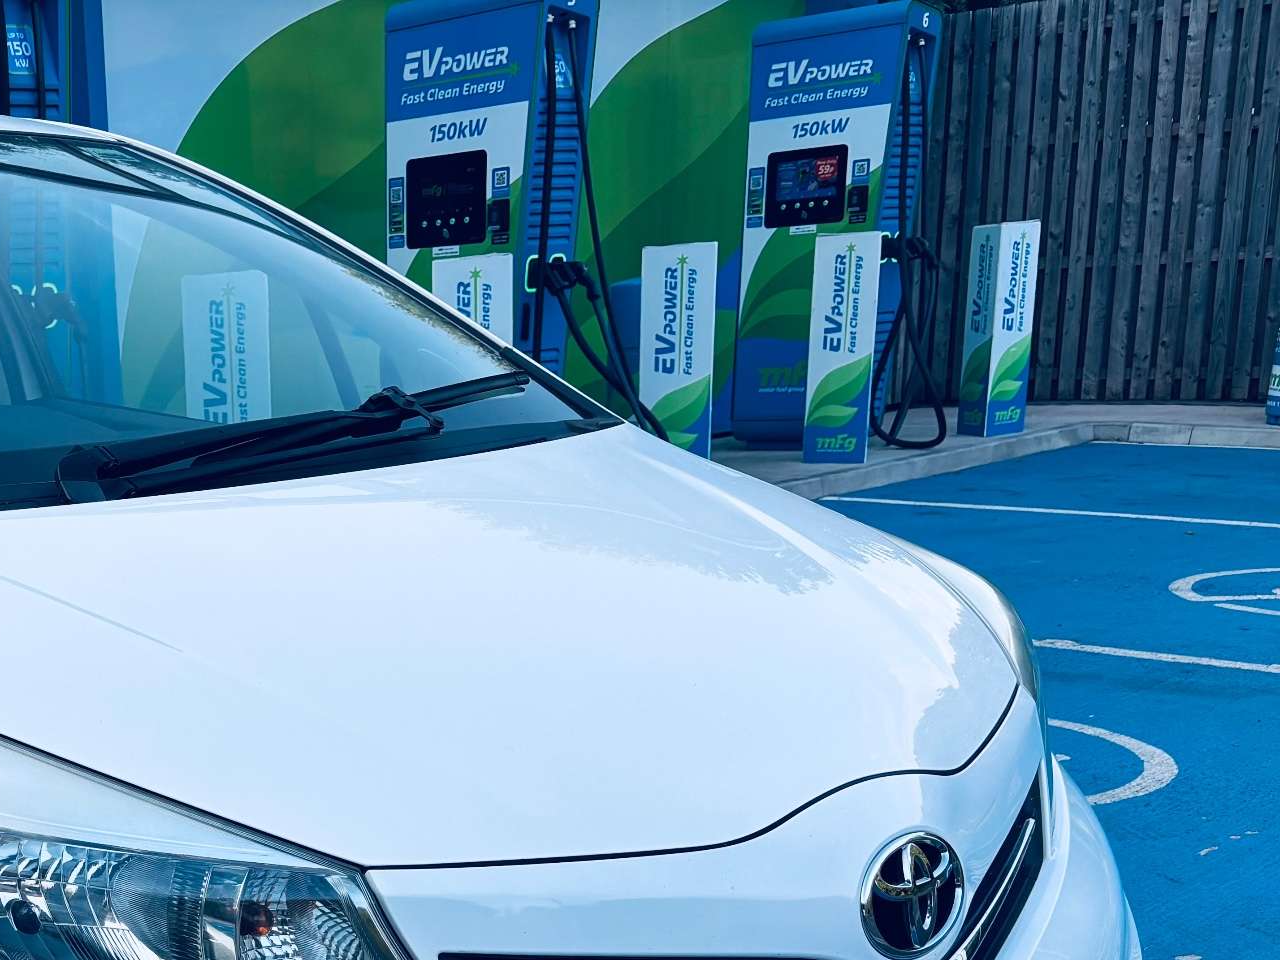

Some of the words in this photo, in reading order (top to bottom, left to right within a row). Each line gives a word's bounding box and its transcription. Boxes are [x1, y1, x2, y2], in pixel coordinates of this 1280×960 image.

[922, 12, 930, 28] 6
[7, 41, 32, 56] 150
[400, 91, 424, 106] Fast
[426, 84, 460, 101] Clean
[462, 79, 505, 96] Energy
[764, 95, 789, 108] Fast
[791, 89, 823, 104] Clean
[826, 85, 869, 100] Energy
[429, 117, 487, 143] 150kW
[791, 117, 850, 139] 150kW
[1022, 242, 1031, 278] Energy
[685, 267, 698, 311] Energy
[852, 255, 864, 296] Energy
[481, 283, 492, 329] Energy
[849, 297, 861, 329] Clean
[235, 302, 246, 354] Energy
[684, 314, 696, 349] Clean
[847, 330, 857, 353] Fast
[682, 349, 693, 375] Fast
[236, 359, 247, 399] Clean
[816, 434, 857, 453] mfg
